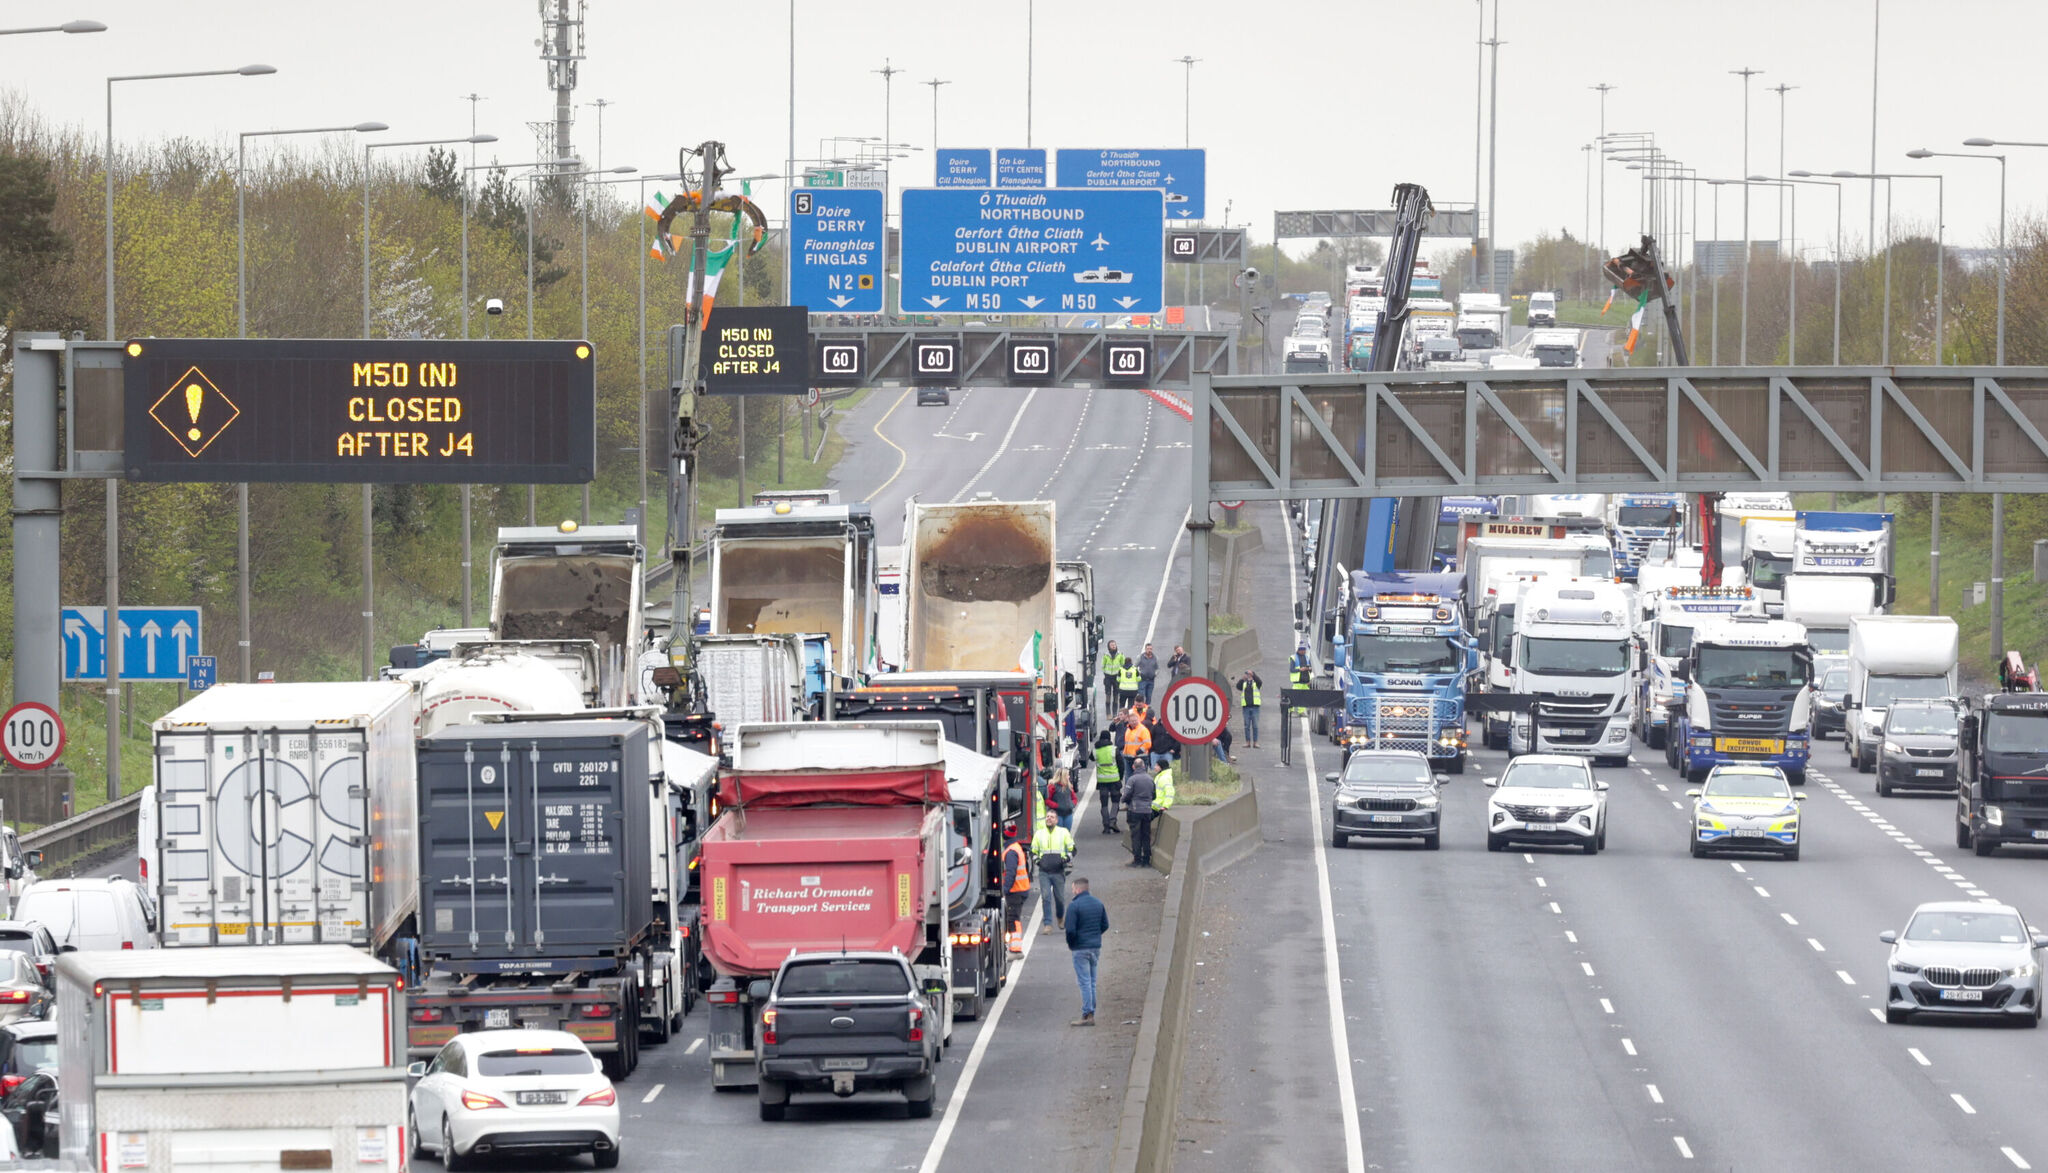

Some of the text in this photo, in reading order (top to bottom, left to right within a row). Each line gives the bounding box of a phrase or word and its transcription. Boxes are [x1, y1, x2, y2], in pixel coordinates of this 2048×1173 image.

[950, 166, 978, 174] DERRY
[1016, 166, 1043, 174] CENTRE
[1138, 170, 1160, 178] Cliath
[798, 196, 809, 212] 5
[980, 192, 1047, 206] Ó Thuaidh
[817, 206, 851, 217] Doire
[980, 209, 1084, 220] NORTHBOUND
[817, 220, 866, 232] DERRY
[1044, 228, 1084, 239] Cliath
[804, 239, 875, 252] Fionnghlas
[956, 242, 1078, 254] DUBLIN AIRPORT
[1179, 241, 1189, 251] 60
[805, 254, 867, 265] FINGLAS
[930, 260, 984, 272] Calafort
[1027, 261, 1065, 272] Cliath
[931, 275, 1029, 287] DUBLIN PORT
[721, 328, 772, 341] M50 (N)
[719, 344, 774, 358] CLOSED
[832, 351, 1135, 368] 60 60 60 60
[713, 361, 780, 375] AFTER J4
[353, 362, 457, 388] M50 (N)
[349, 397, 461, 422] CLOSED
[338, 432, 473, 456] AFTER J4
[1443, 506, 1482, 514] DIXON
[1488, 524, 1543, 535] MULGREW
[199, 669, 207, 677] N
[1012, 696, 1024, 704] 26
[1172, 694, 1217, 722] 100
[9, 720, 53, 747] 100
[1182, 725, 1208, 735] km/h
[18, 751, 45, 760] km/h
[553, 762, 572, 773] GVTU
[579, 762, 608, 773] 260129
[580, 775, 598, 786] 22G1
[546, 818, 560, 828] TARE
[546, 831, 571, 841] PAYLOAD
[753, 886, 874, 899] Richard Ormonde
[756, 901, 871, 915] Transport Services
